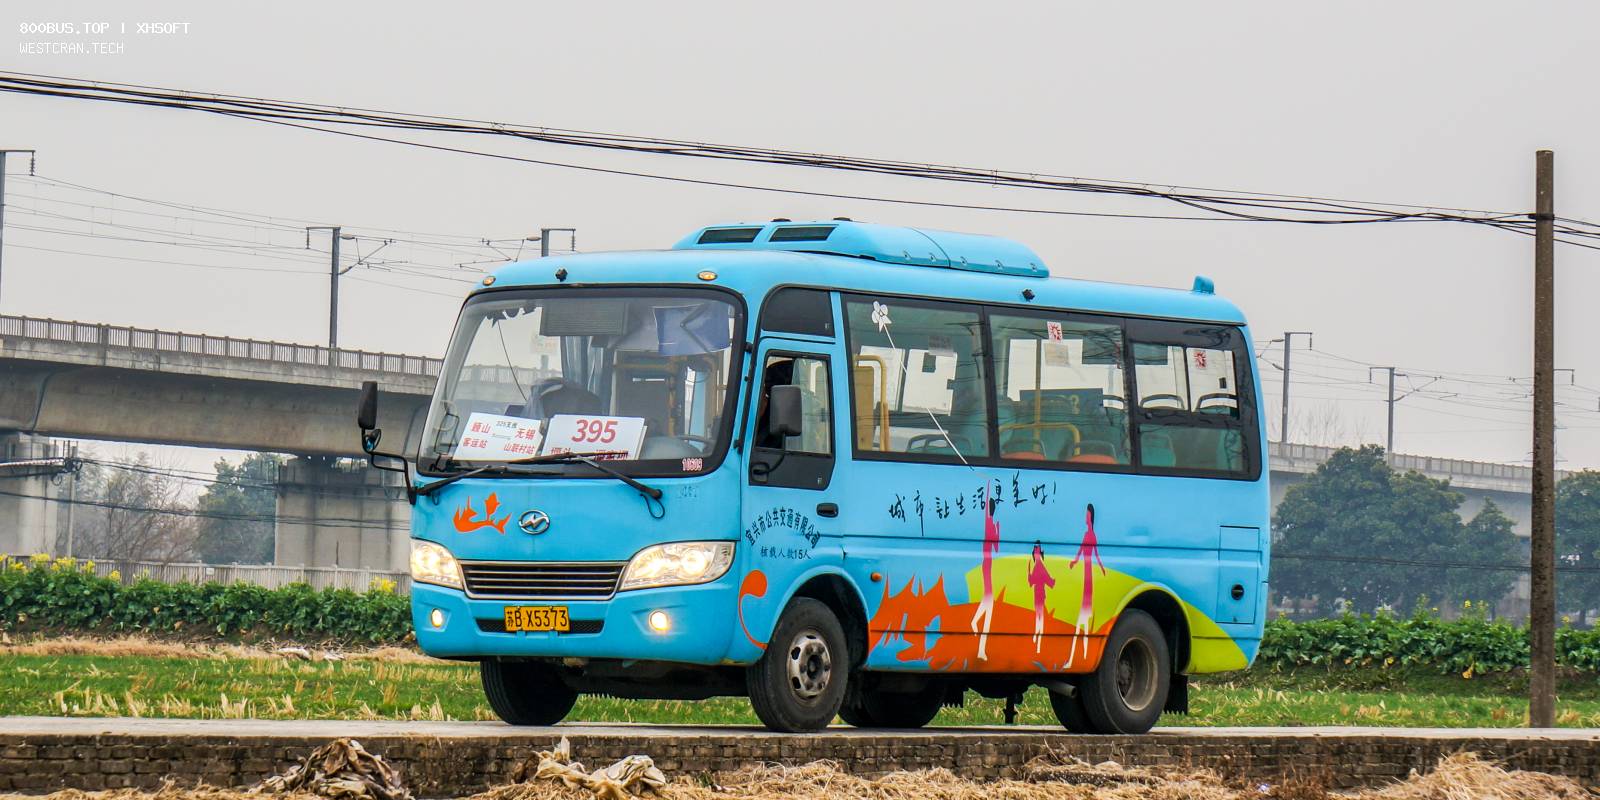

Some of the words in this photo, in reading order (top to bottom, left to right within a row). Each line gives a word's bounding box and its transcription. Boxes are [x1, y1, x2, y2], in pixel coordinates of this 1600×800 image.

[571, 418, 618, 444] 395
[745, 506, 821, 549] 宜兴市公共交通有限公司
